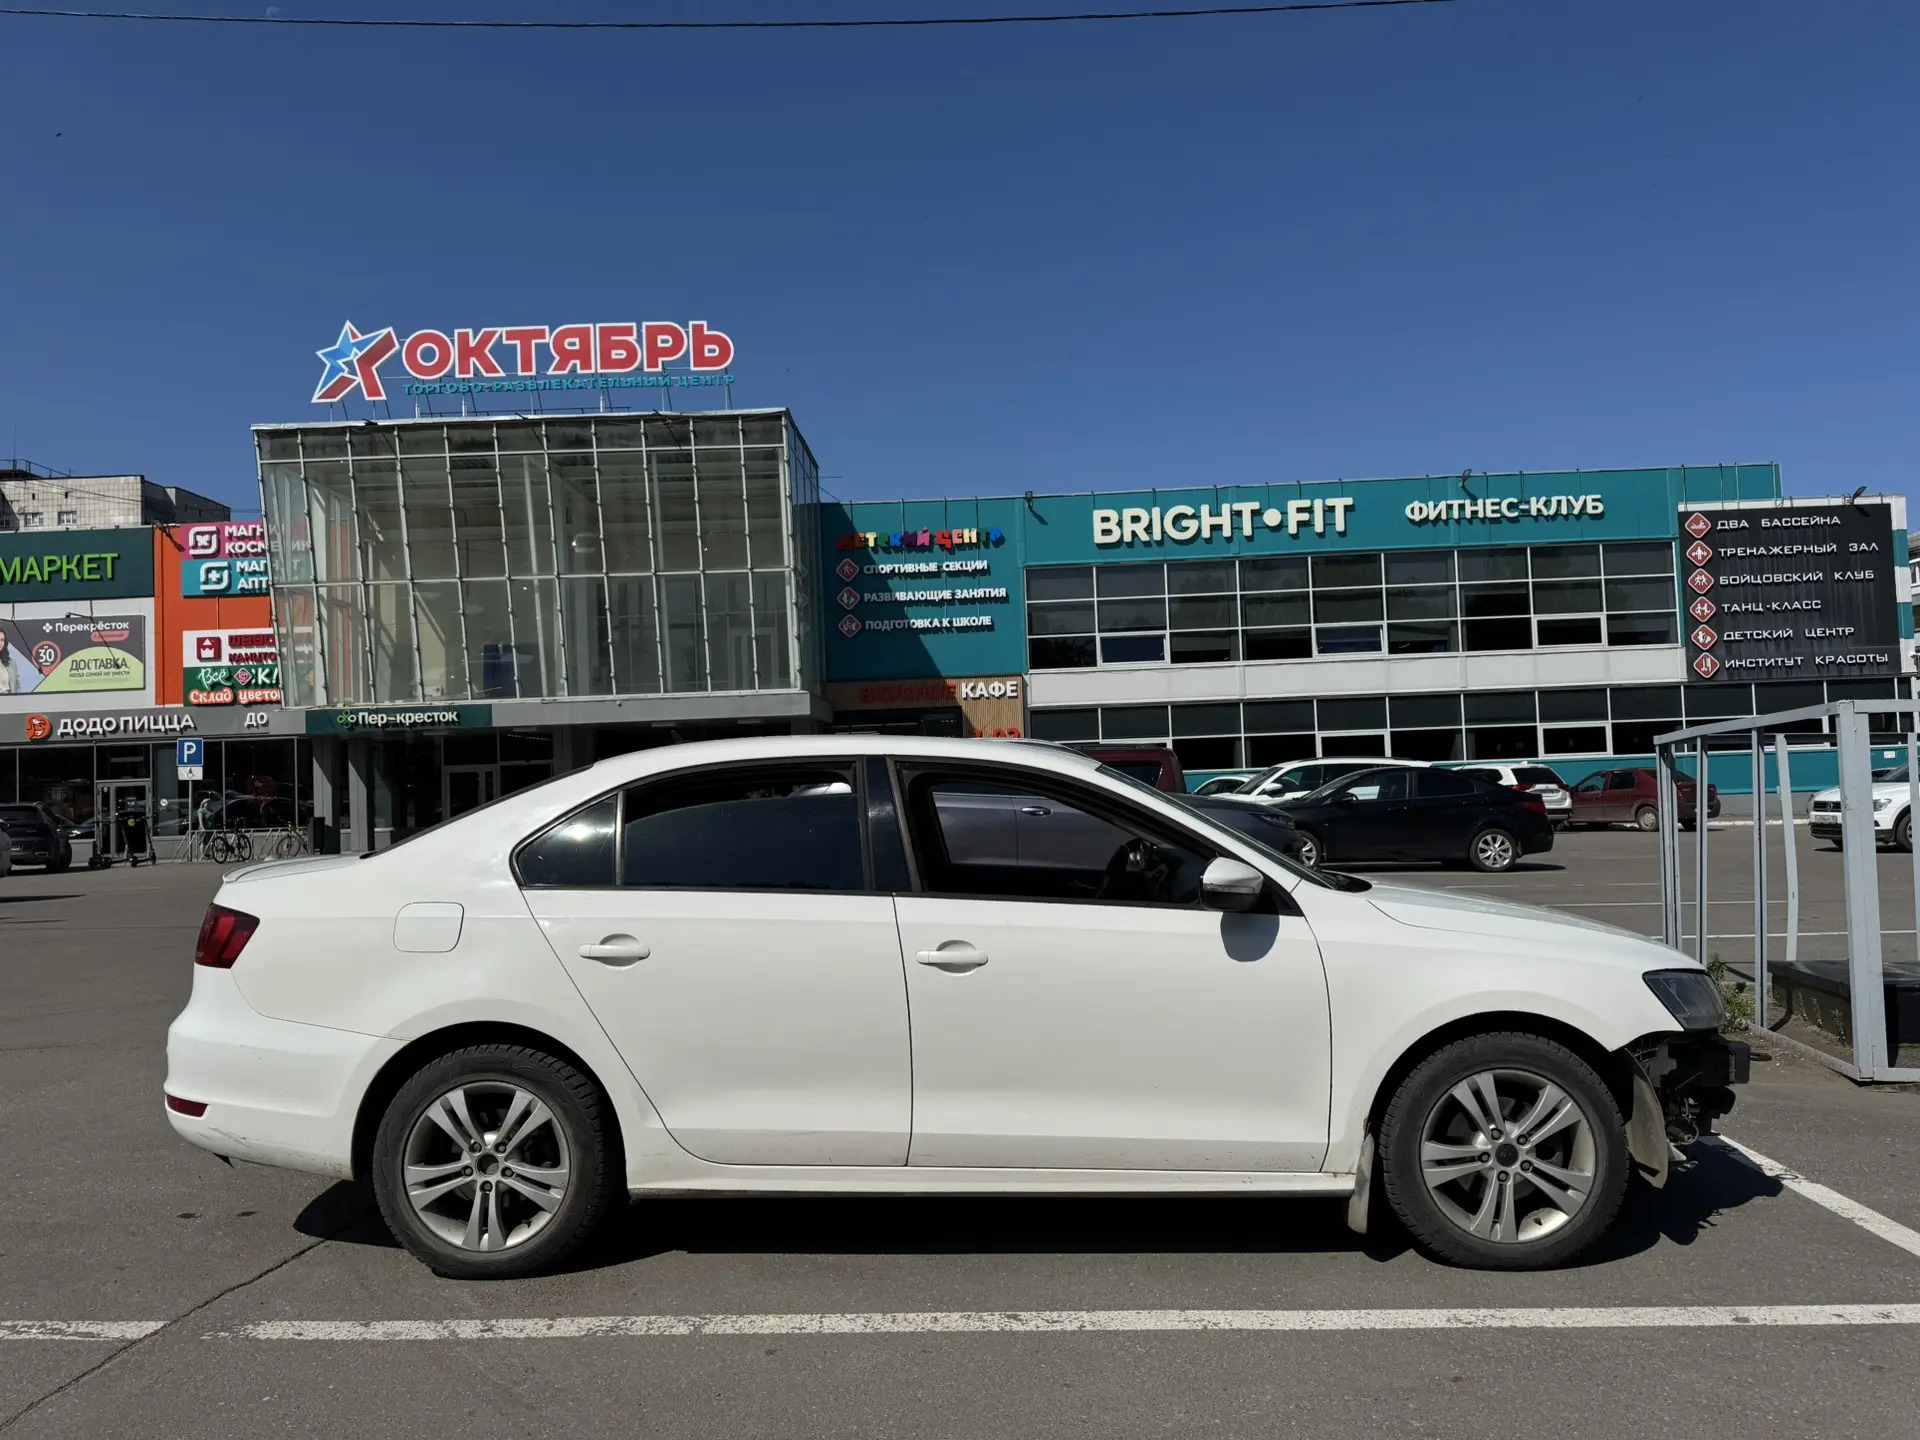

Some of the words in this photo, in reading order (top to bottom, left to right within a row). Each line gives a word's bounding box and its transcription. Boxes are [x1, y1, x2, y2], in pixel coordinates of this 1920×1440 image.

[402, 321, 734, 380] ОКТЯБРЬ
[402, 372, 671, 395] ТОРГОВО-РАЗВЛЕКАТЕЛЬНЫЙ
[678, 375, 735, 389] ЦЕНТР
[1405, 494, 1604, 522] ФИТНЕС-КЛУБ
[1716, 520, 1750, 530] ДВА
[1761, 515, 1841, 528] БАССЕЙНА
[838, 526, 931, 551] ДЕТСКИЙ
[936, 527, 1004, 548] ЦЕНТР
[1718, 543, 1837, 557] ТРЕНАЖЕРНЫЙ
[1848, 542, 1879, 552] ЗАЛ
[0, 553, 118, 582] МАРКЕТ
[863, 562, 938, 574] СПОРТИВНЫЕ
[942, 560, 988, 572] СЕКЦИИ
[1719, 571, 1823, 585] БОЙЦОВСКИЙ
[1834, 570, 1875, 581] КЛУБ
[864, 590, 952, 602] РАЗВИВАЮЩИЕ
[955, 587, 1007, 599] ЗАНЯТИЯ
[1721, 600, 1822, 612] ТАНЦ-КЛАСС
[865, 618, 940, 631] ПОДГОТОВКА
[942, 617, 950, 628] К
[952, 616, 992, 627] ШКОЛЕ
[1723, 628, 1793, 641] ДЕТСКИЙ
[1805, 627, 1855, 638] ЦЕНТР
[38, 649, 55, 662] 30
[1725, 657, 1804, 669] ИНСТИТУТ
[1815, 653, 1889, 665] КРАСОТЫ
[189, 688, 233, 703] Склад
[239, 690, 281, 704] цвето
[861, 683, 956, 703] ВКУСНОЕ
[961, 681, 1018, 699] КАФЕ
[57, 718, 117, 736] ДОДО
[120, 714, 194, 732] ПИЦЦА
